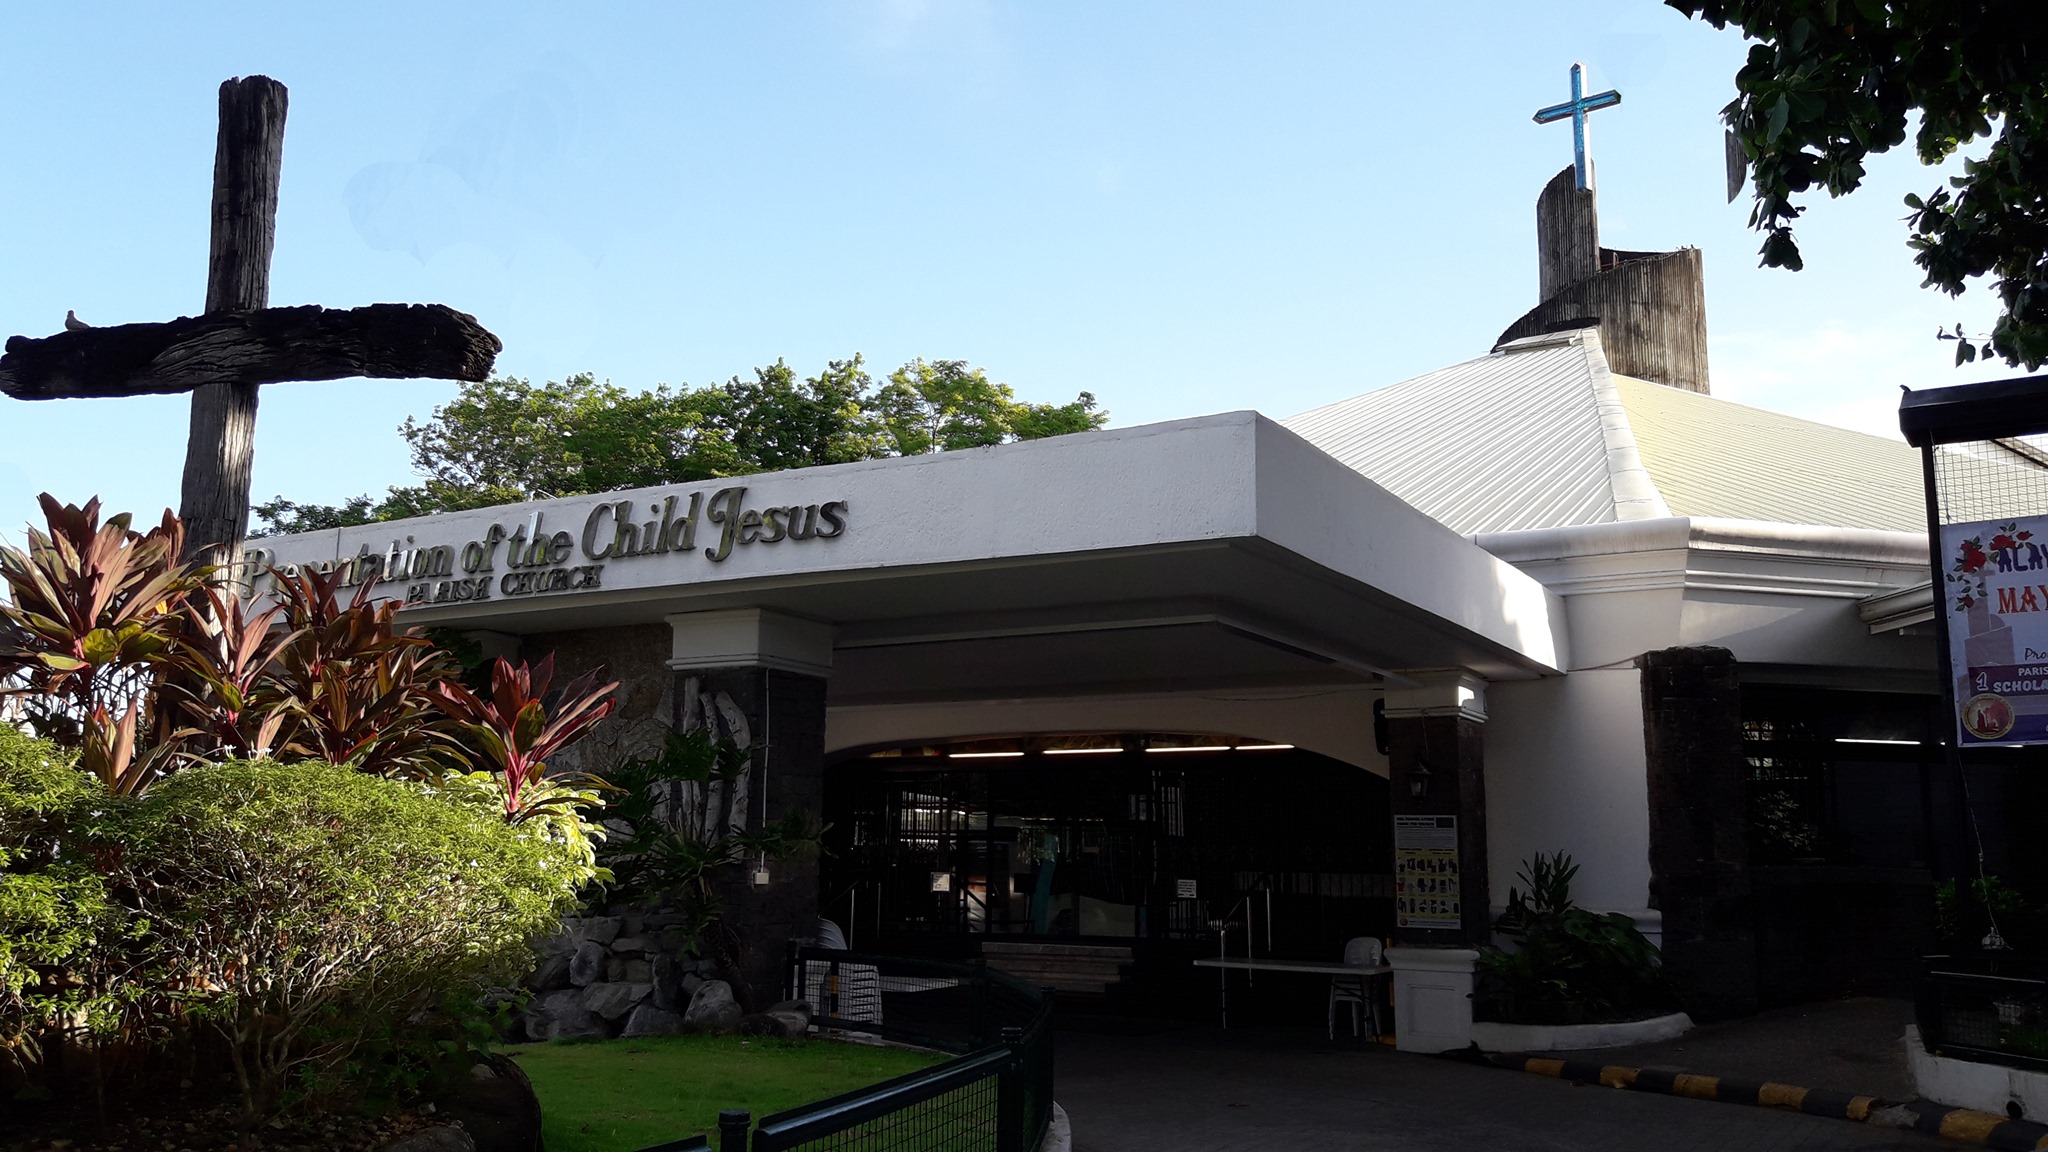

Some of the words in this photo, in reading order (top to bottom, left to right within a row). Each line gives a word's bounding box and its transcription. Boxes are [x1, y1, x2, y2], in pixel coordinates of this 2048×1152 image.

[460, 523, 507, 574] of
[506, 511, 575, 570] the
[581, 491, 705, 561] Child
[704, 486, 848, 563] Jesus
[406, 575, 494, 603] PARISH
[501, 565, 605, 596] CHURCH
[1975, 671, 1989, 691] 1
